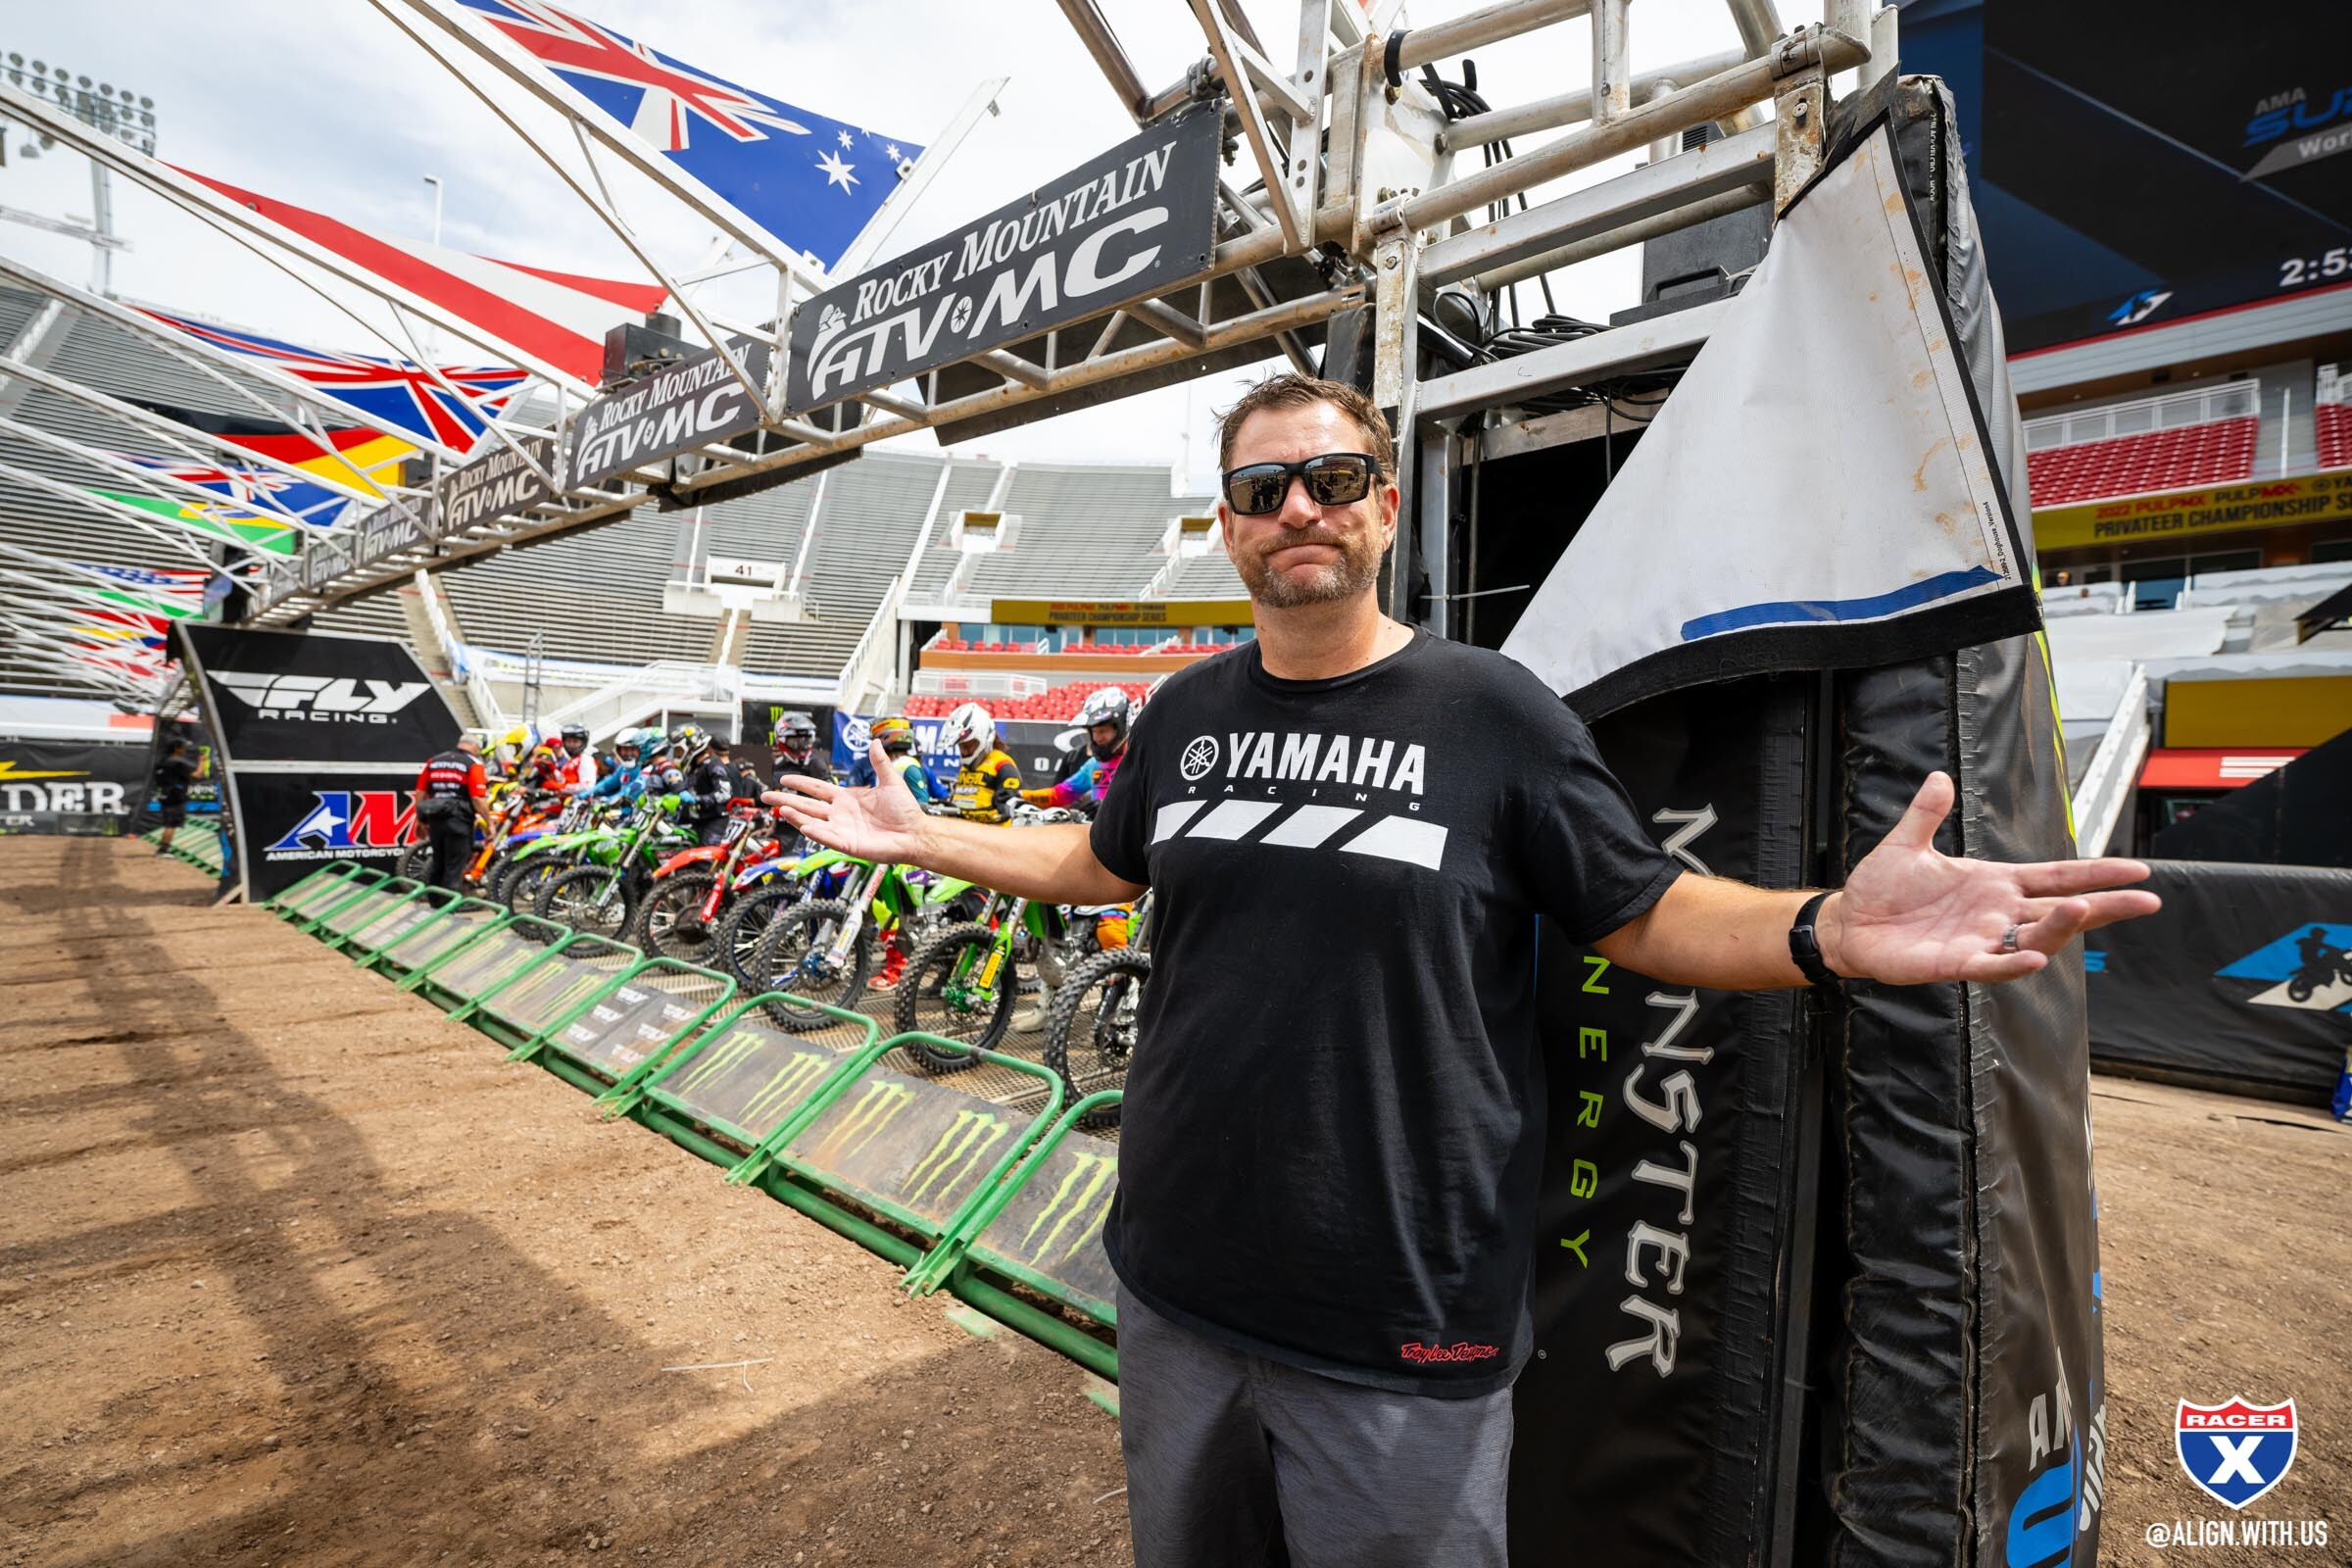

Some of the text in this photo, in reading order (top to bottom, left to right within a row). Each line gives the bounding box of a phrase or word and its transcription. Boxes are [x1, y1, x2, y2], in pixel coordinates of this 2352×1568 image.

[2242, 84, 2352, 146] SU
[2255, 87, 2305, 116] AMA
[2298, 131, 2352, 159] Wor
[851, 141, 1177, 325] ROCKY MOUNTAIN
[598, 389, 649, 432] ROCKY
[459, 464, 487, 494] ROCKY
[2094, 513, 2184, 538] PRIVATEER
[2188, 495, 2330, 528] CHAMPIONSHIP
[735, 564, 752, 576] 41
[225, 670, 431, 712] FLY
[258, 709, 388, 724] RACING
[1226, 732, 1426, 796] YAMAHA
[1188, 784, 1420, 811] RACING
[264, 791, 418, 851] AM
[267, 848, 404, 861] AMERICAN MOTORCYC
[1605, 803, 1719, 1378] MNSTER
[1561, 955, 1613, 1269] NERGY
